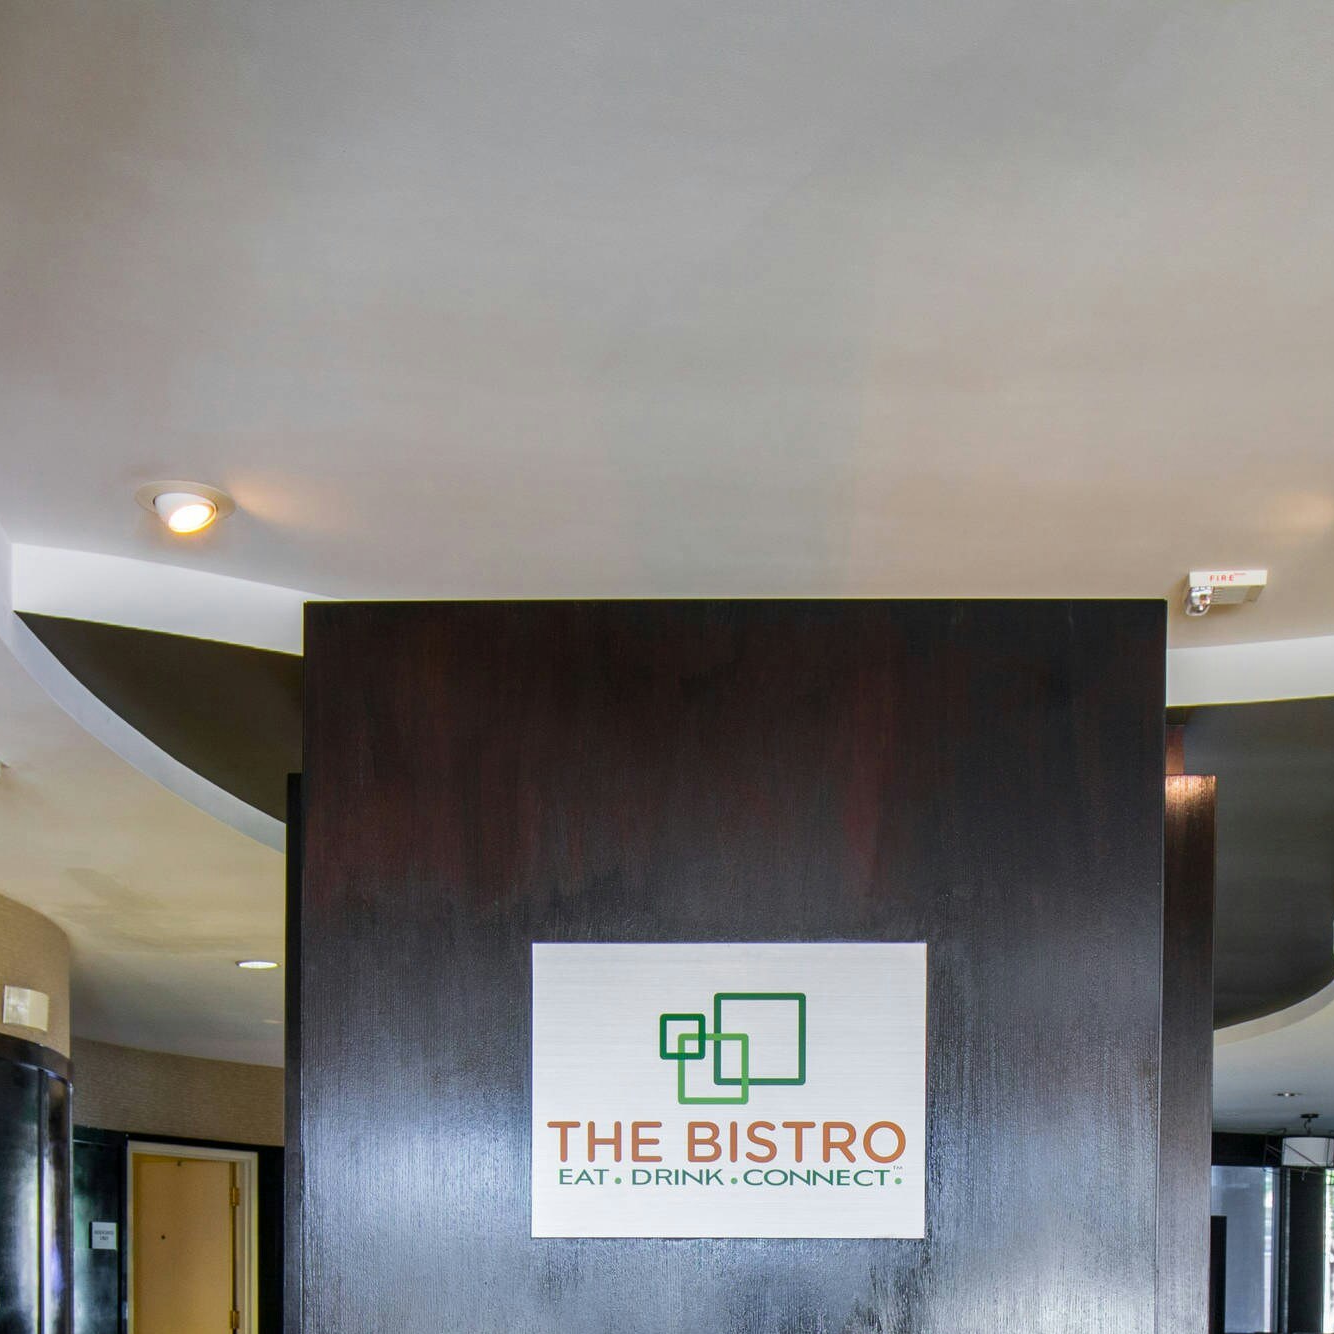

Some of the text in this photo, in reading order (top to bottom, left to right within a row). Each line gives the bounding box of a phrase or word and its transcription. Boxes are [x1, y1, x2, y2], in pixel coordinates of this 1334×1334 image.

[1209, 574, 1234, 582] FIRE
[547, 1120, 907, 1164] THE BISTRO
